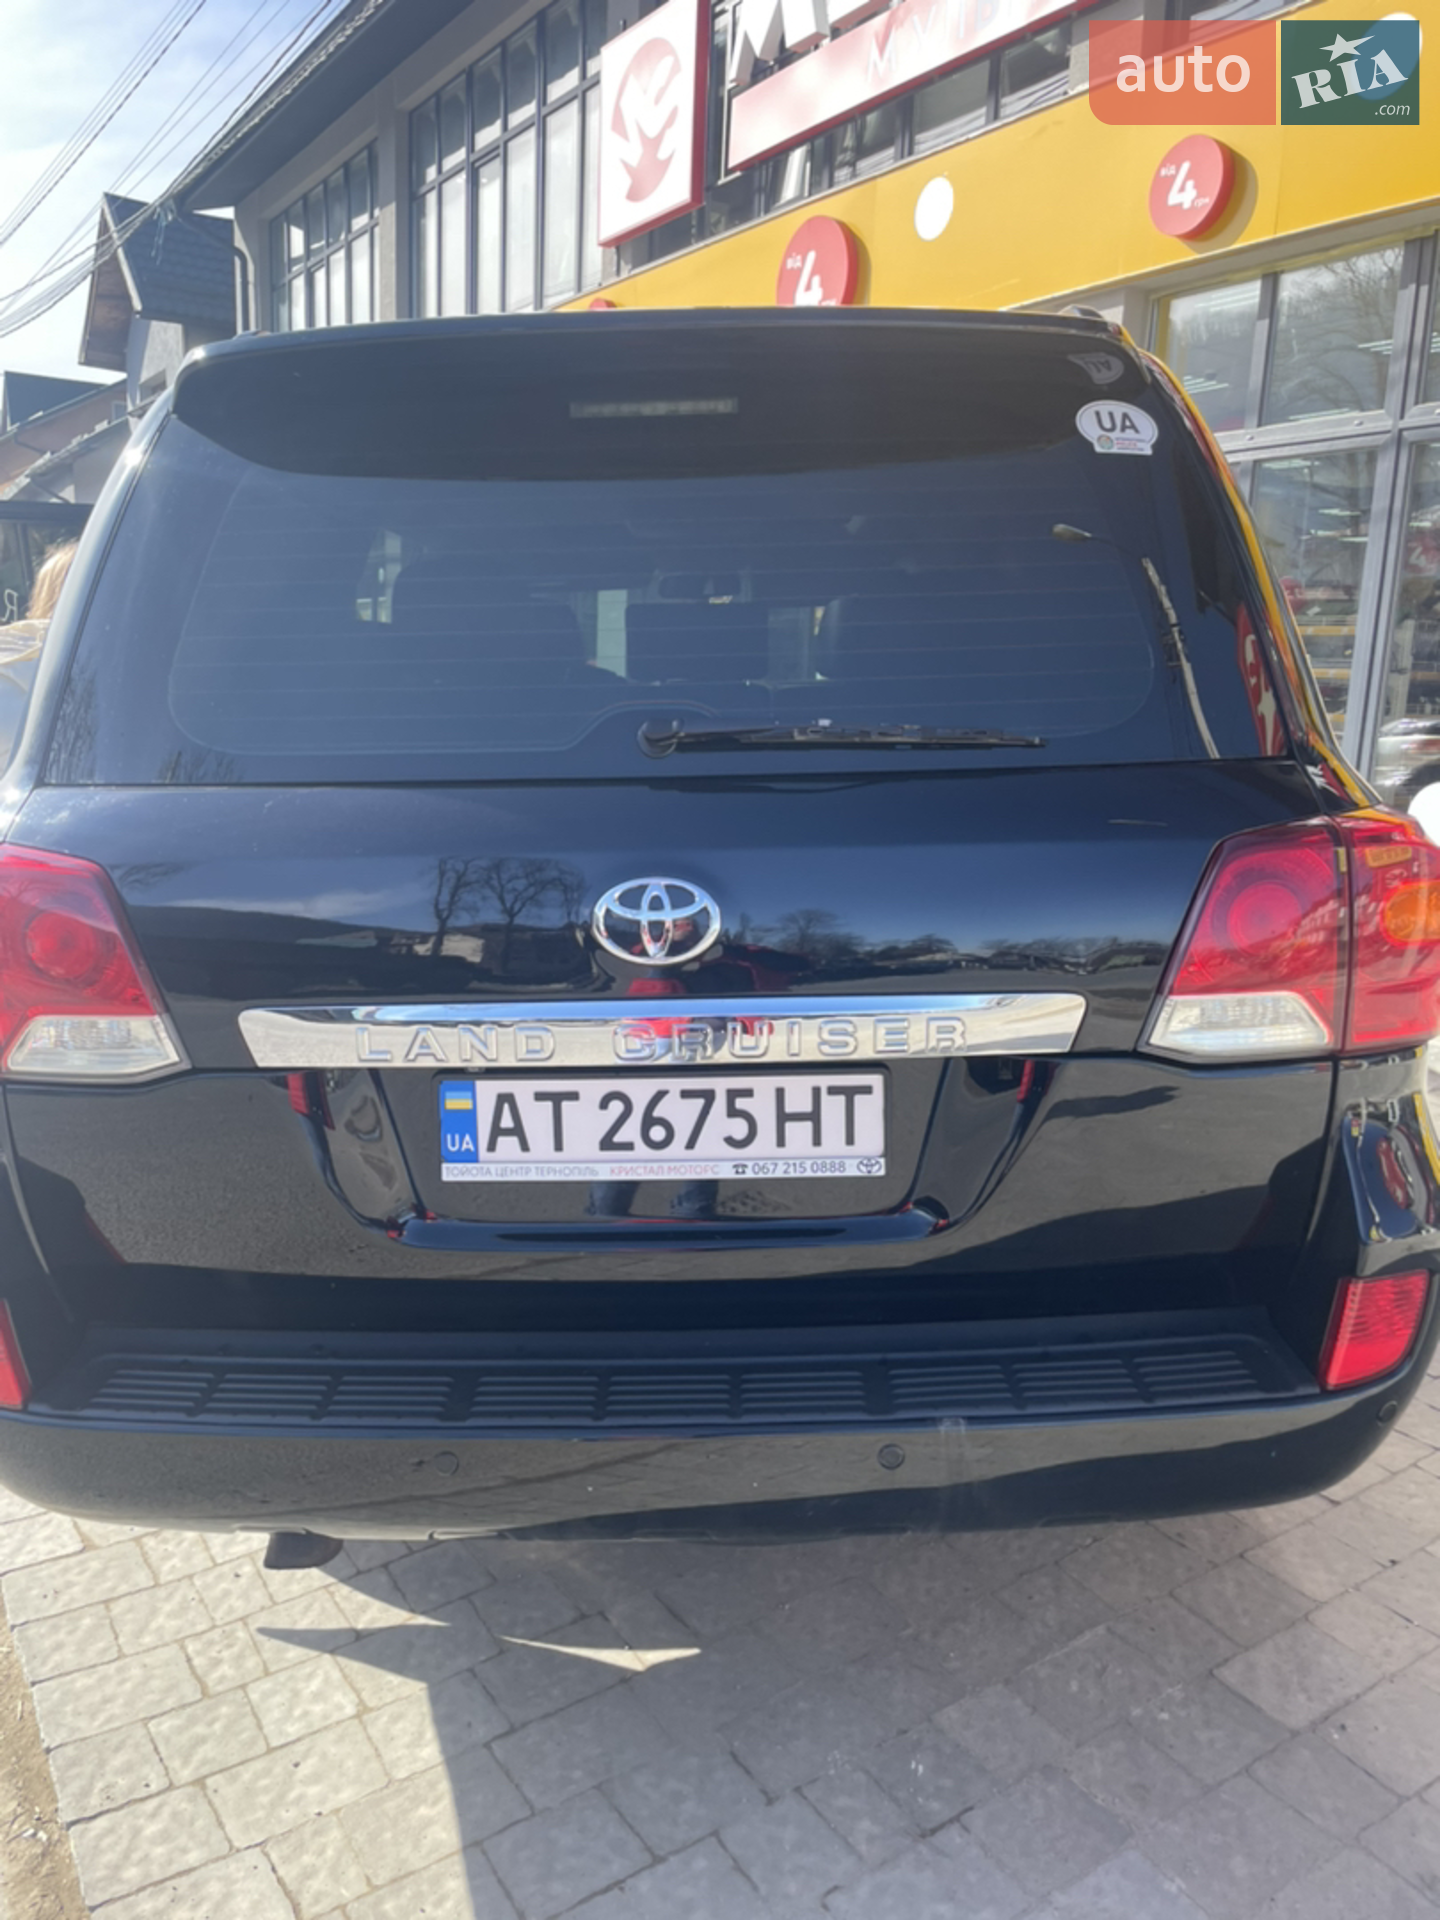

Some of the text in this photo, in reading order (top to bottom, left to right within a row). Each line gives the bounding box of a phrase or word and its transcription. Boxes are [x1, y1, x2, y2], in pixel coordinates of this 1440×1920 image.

[1167, 160, 1198, 210] 4
[794, 249, 823, 307] 4
[1094, 410, 1141, 435] UA
[355, 1016, 967, 1063] LAND CRUISER
[446, 1132, 475, 1153] UA
[598, 1088, 758, 1152] 2675
[445, 1166, 492, 1178] ТОЙОТА
[495, 1166, 531, 1178] ЦЕНТР
[609, 1165, 665, 1177] КРИСТАЛ
[667, 1163, 720, 1176] МОТОРС
[751, 1162, 778, 1175] 067
[783, 1161, 807, 1175] 215
[810, 1160, 847, 1174] 0888
